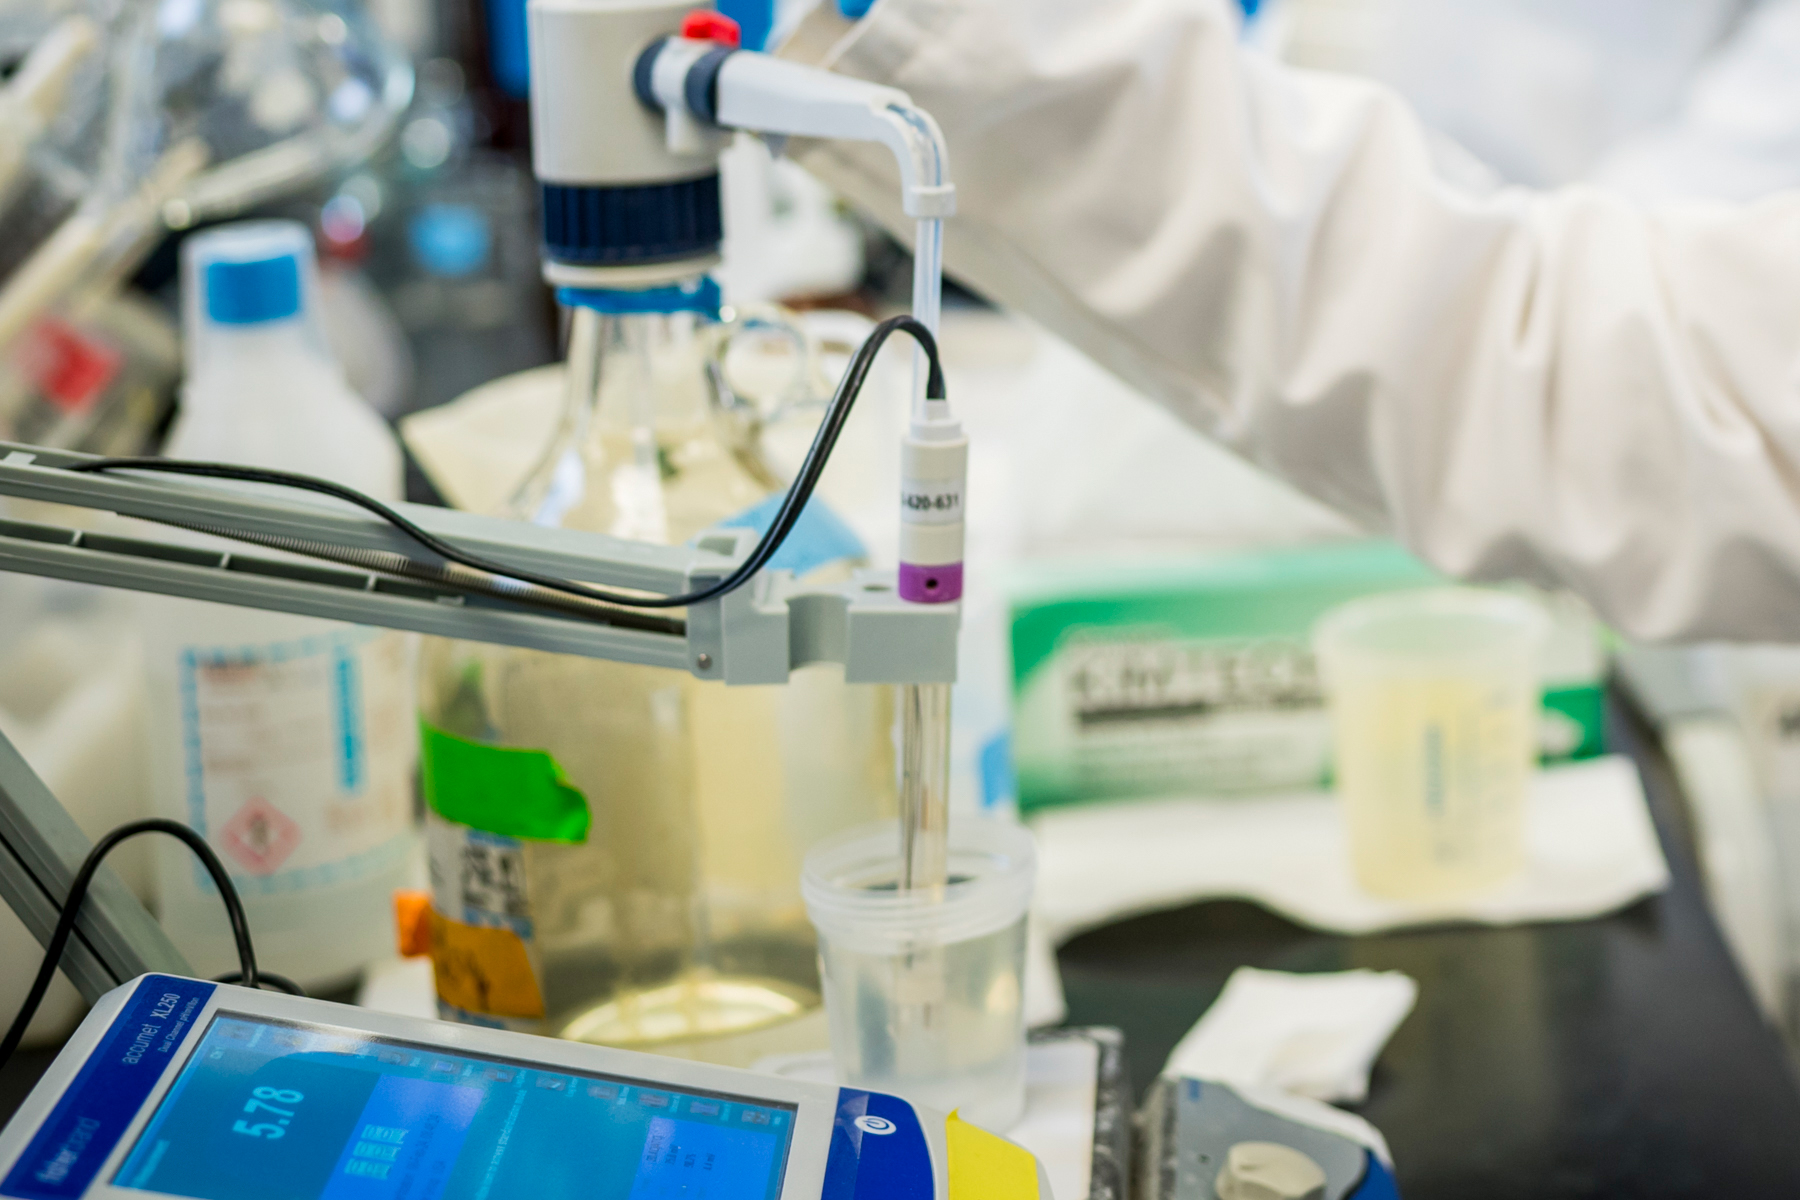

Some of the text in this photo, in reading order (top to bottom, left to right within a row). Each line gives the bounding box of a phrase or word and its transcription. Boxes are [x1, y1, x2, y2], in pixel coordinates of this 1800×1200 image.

[122, 993, 181, 1065] accumet XL250
[158, 1040, 172, 1053] Dual
[165, 1020, 185, 1041] Channel
[232, 1086, 304, 1140] 5.78
